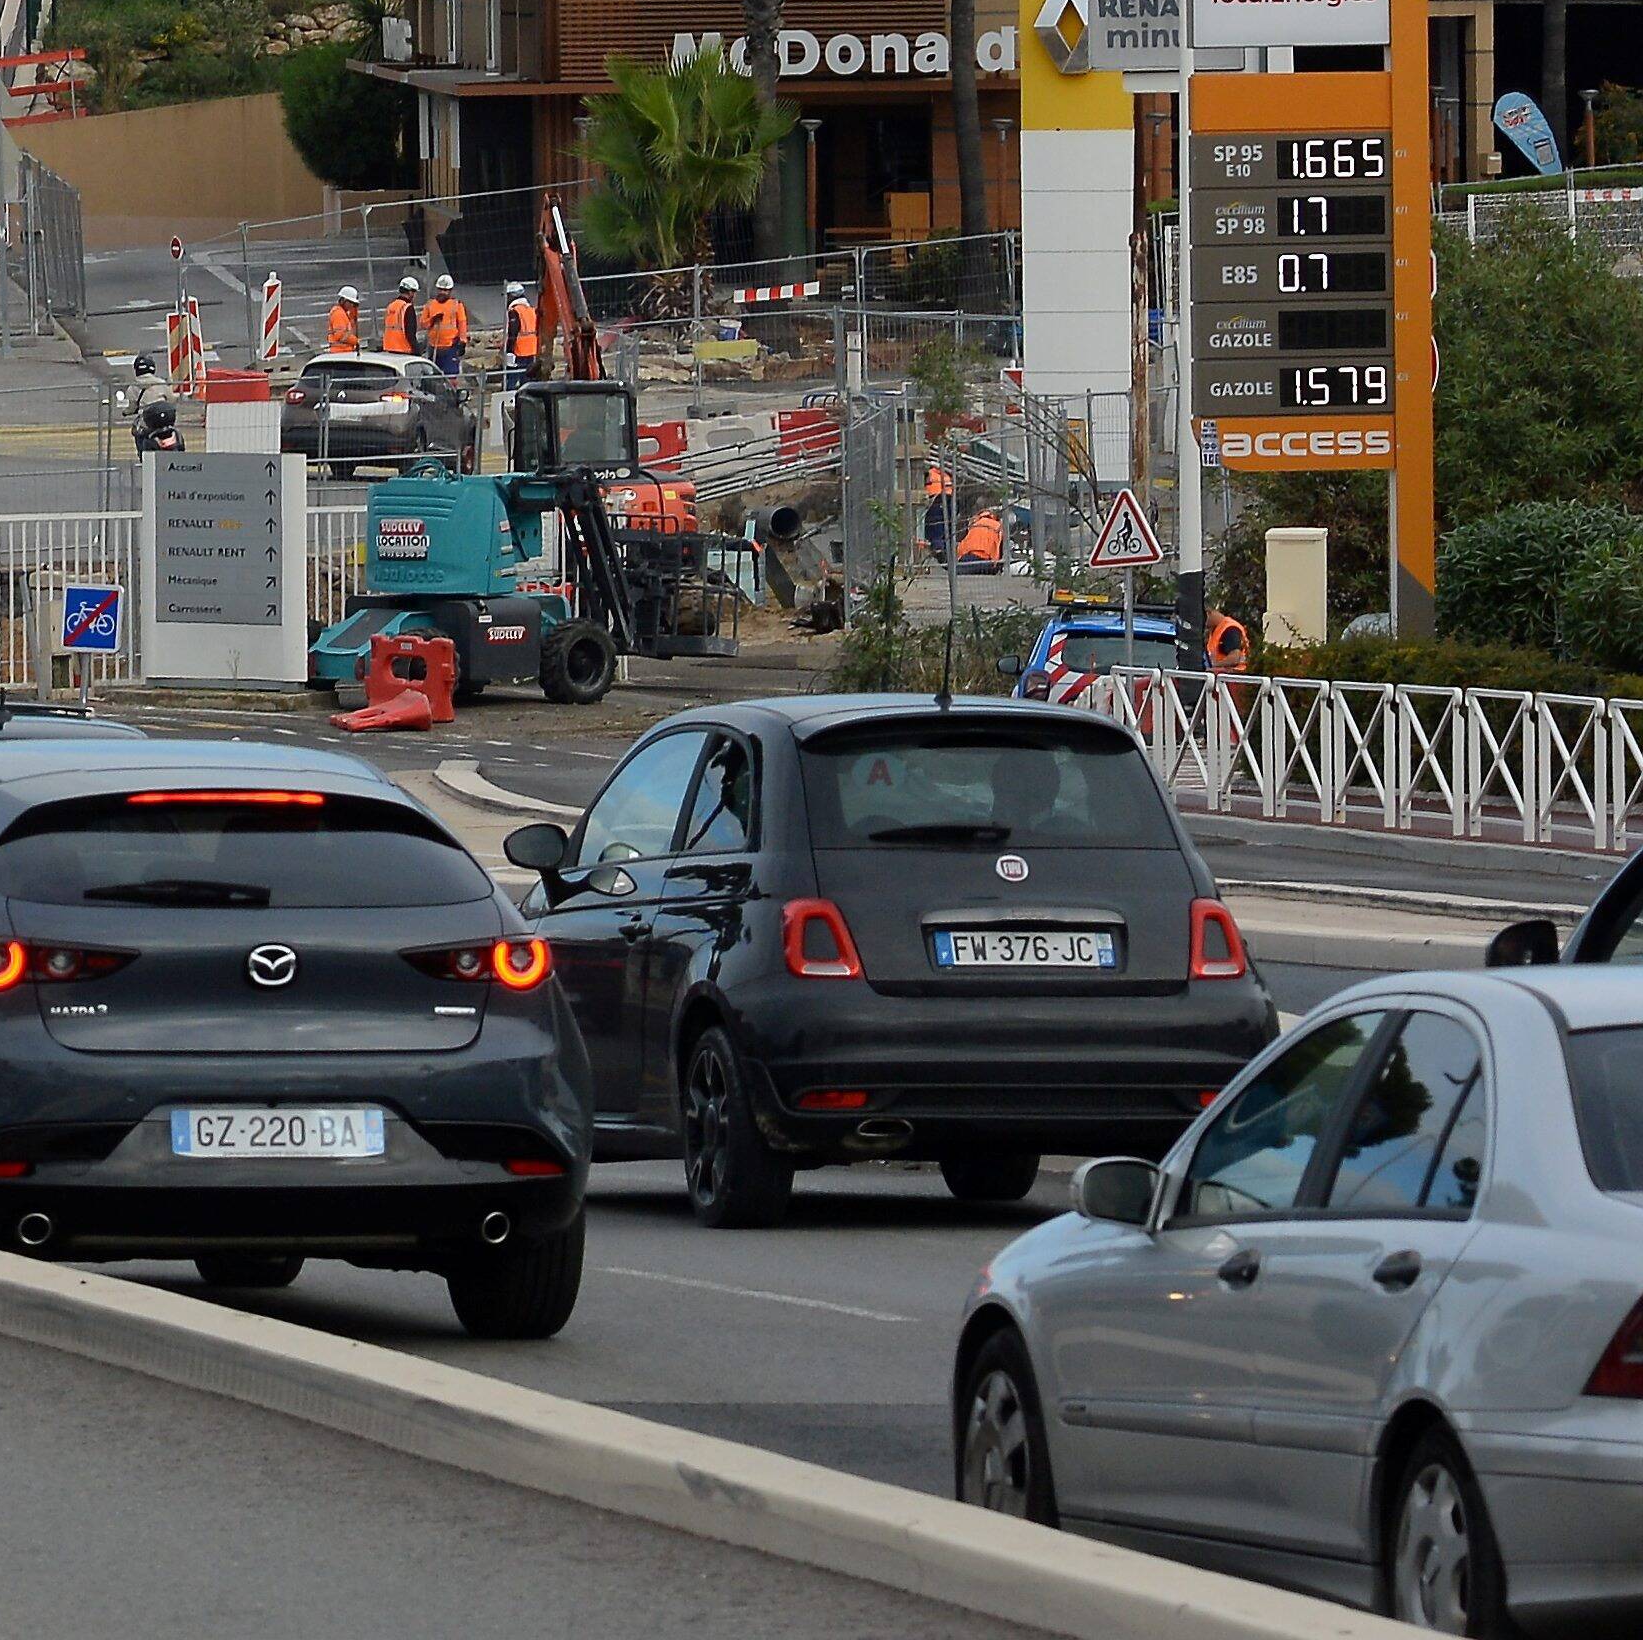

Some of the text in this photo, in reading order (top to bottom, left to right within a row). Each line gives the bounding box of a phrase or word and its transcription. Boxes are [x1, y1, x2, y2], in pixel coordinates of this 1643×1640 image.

[1215, 145, 1263, 162] SP 95
[1292, 138, 1383, 178] 1.665
[1226, 164, 1251, 177] E10
[1293, 196, 1327, 235] 1.7
[1216, 218, 1265, 234] SP 98
[1222, 265, 1258, 284] E85
[1278, 254, 1328, 292] 0.7
[1209, 333, 1272, 348] GAZOLE
[1210, 381, 1274, 397] GAZOLE
[1295, 366, 1387, 405] 1.579
[168, 462, 203, 472] Accueil
[168, 491, 187, 500] Hall
[168, 519, 214, 528] RENAULT
[380, 520, 421, 533] SUDELEV
[377, 535, 429, 547] LOCATION
[168, 548, 246, 557] RENAULT RENT
[168, 575, 218, 587] Mécanique
[168, 603, 222, 614] Carrosserie
[487, 627, 525, 640] SUDELEV
[867, 759, 894, 786] A
[953, 936, 1094, 962] FW-376-JC
[197, 1116, 358, 1148] GZ-220-BA
